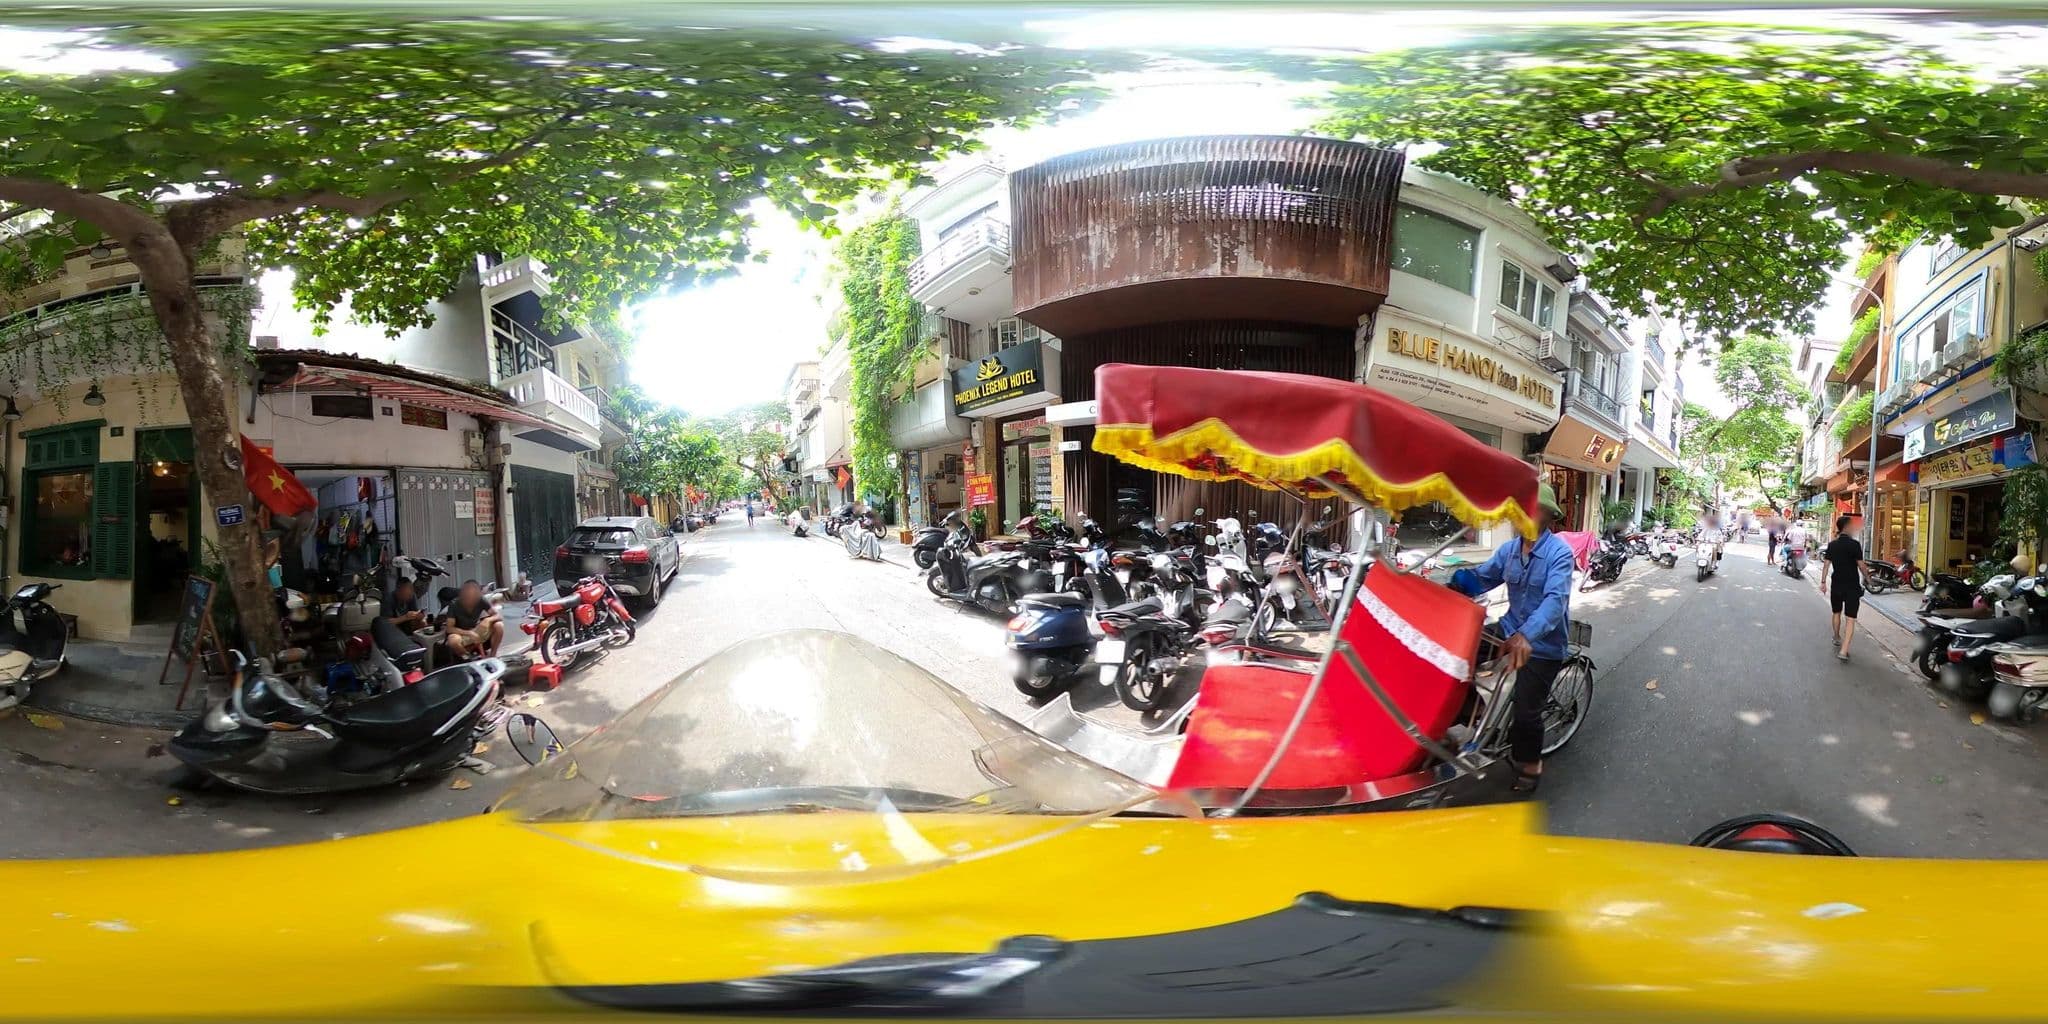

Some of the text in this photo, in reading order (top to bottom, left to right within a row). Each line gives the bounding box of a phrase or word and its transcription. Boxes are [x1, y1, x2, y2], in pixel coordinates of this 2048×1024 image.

[955, 386, 981, 406] PHOENIX
[982, 377, 1008, 397] LEGEND
[1010, 369, 1036, 389] HOTEL
[1387, 328, 1440, 363] BLUE
[1442, 344, 1497, 382] HANOI
[1519, 374, 1556, 409] HOTEL
